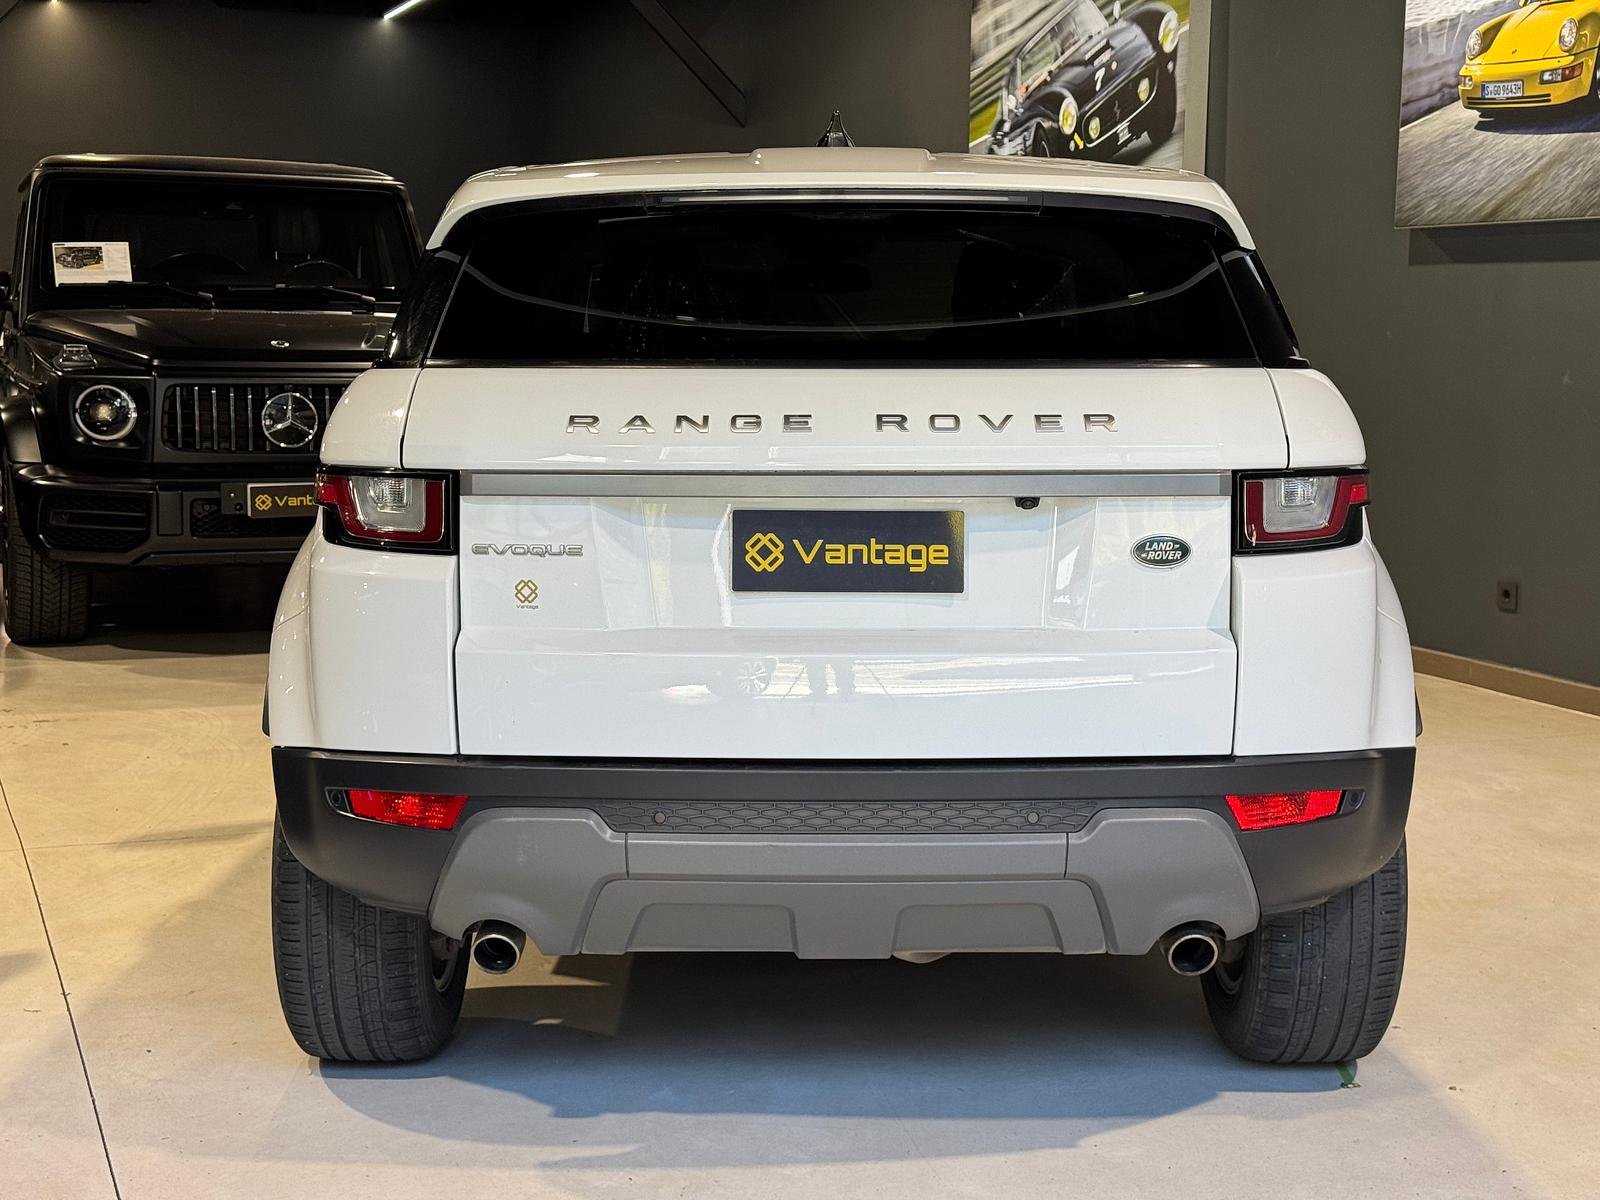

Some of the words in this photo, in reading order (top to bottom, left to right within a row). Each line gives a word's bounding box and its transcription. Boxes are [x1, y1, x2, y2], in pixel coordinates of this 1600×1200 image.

[1094, 66, 1106, 92] 7
[565, 413, 813, 434] RANGE
[875, 413, 1119, 434] ROVER
[274, 494, 316, 507] Vant
[472, 543, 584, 557] EVOQUE
[1144, 541, 1174, 551] LAND
[792, 537, 949, 573] Vantage
[1146, 550, 1182, 560] ROVER
